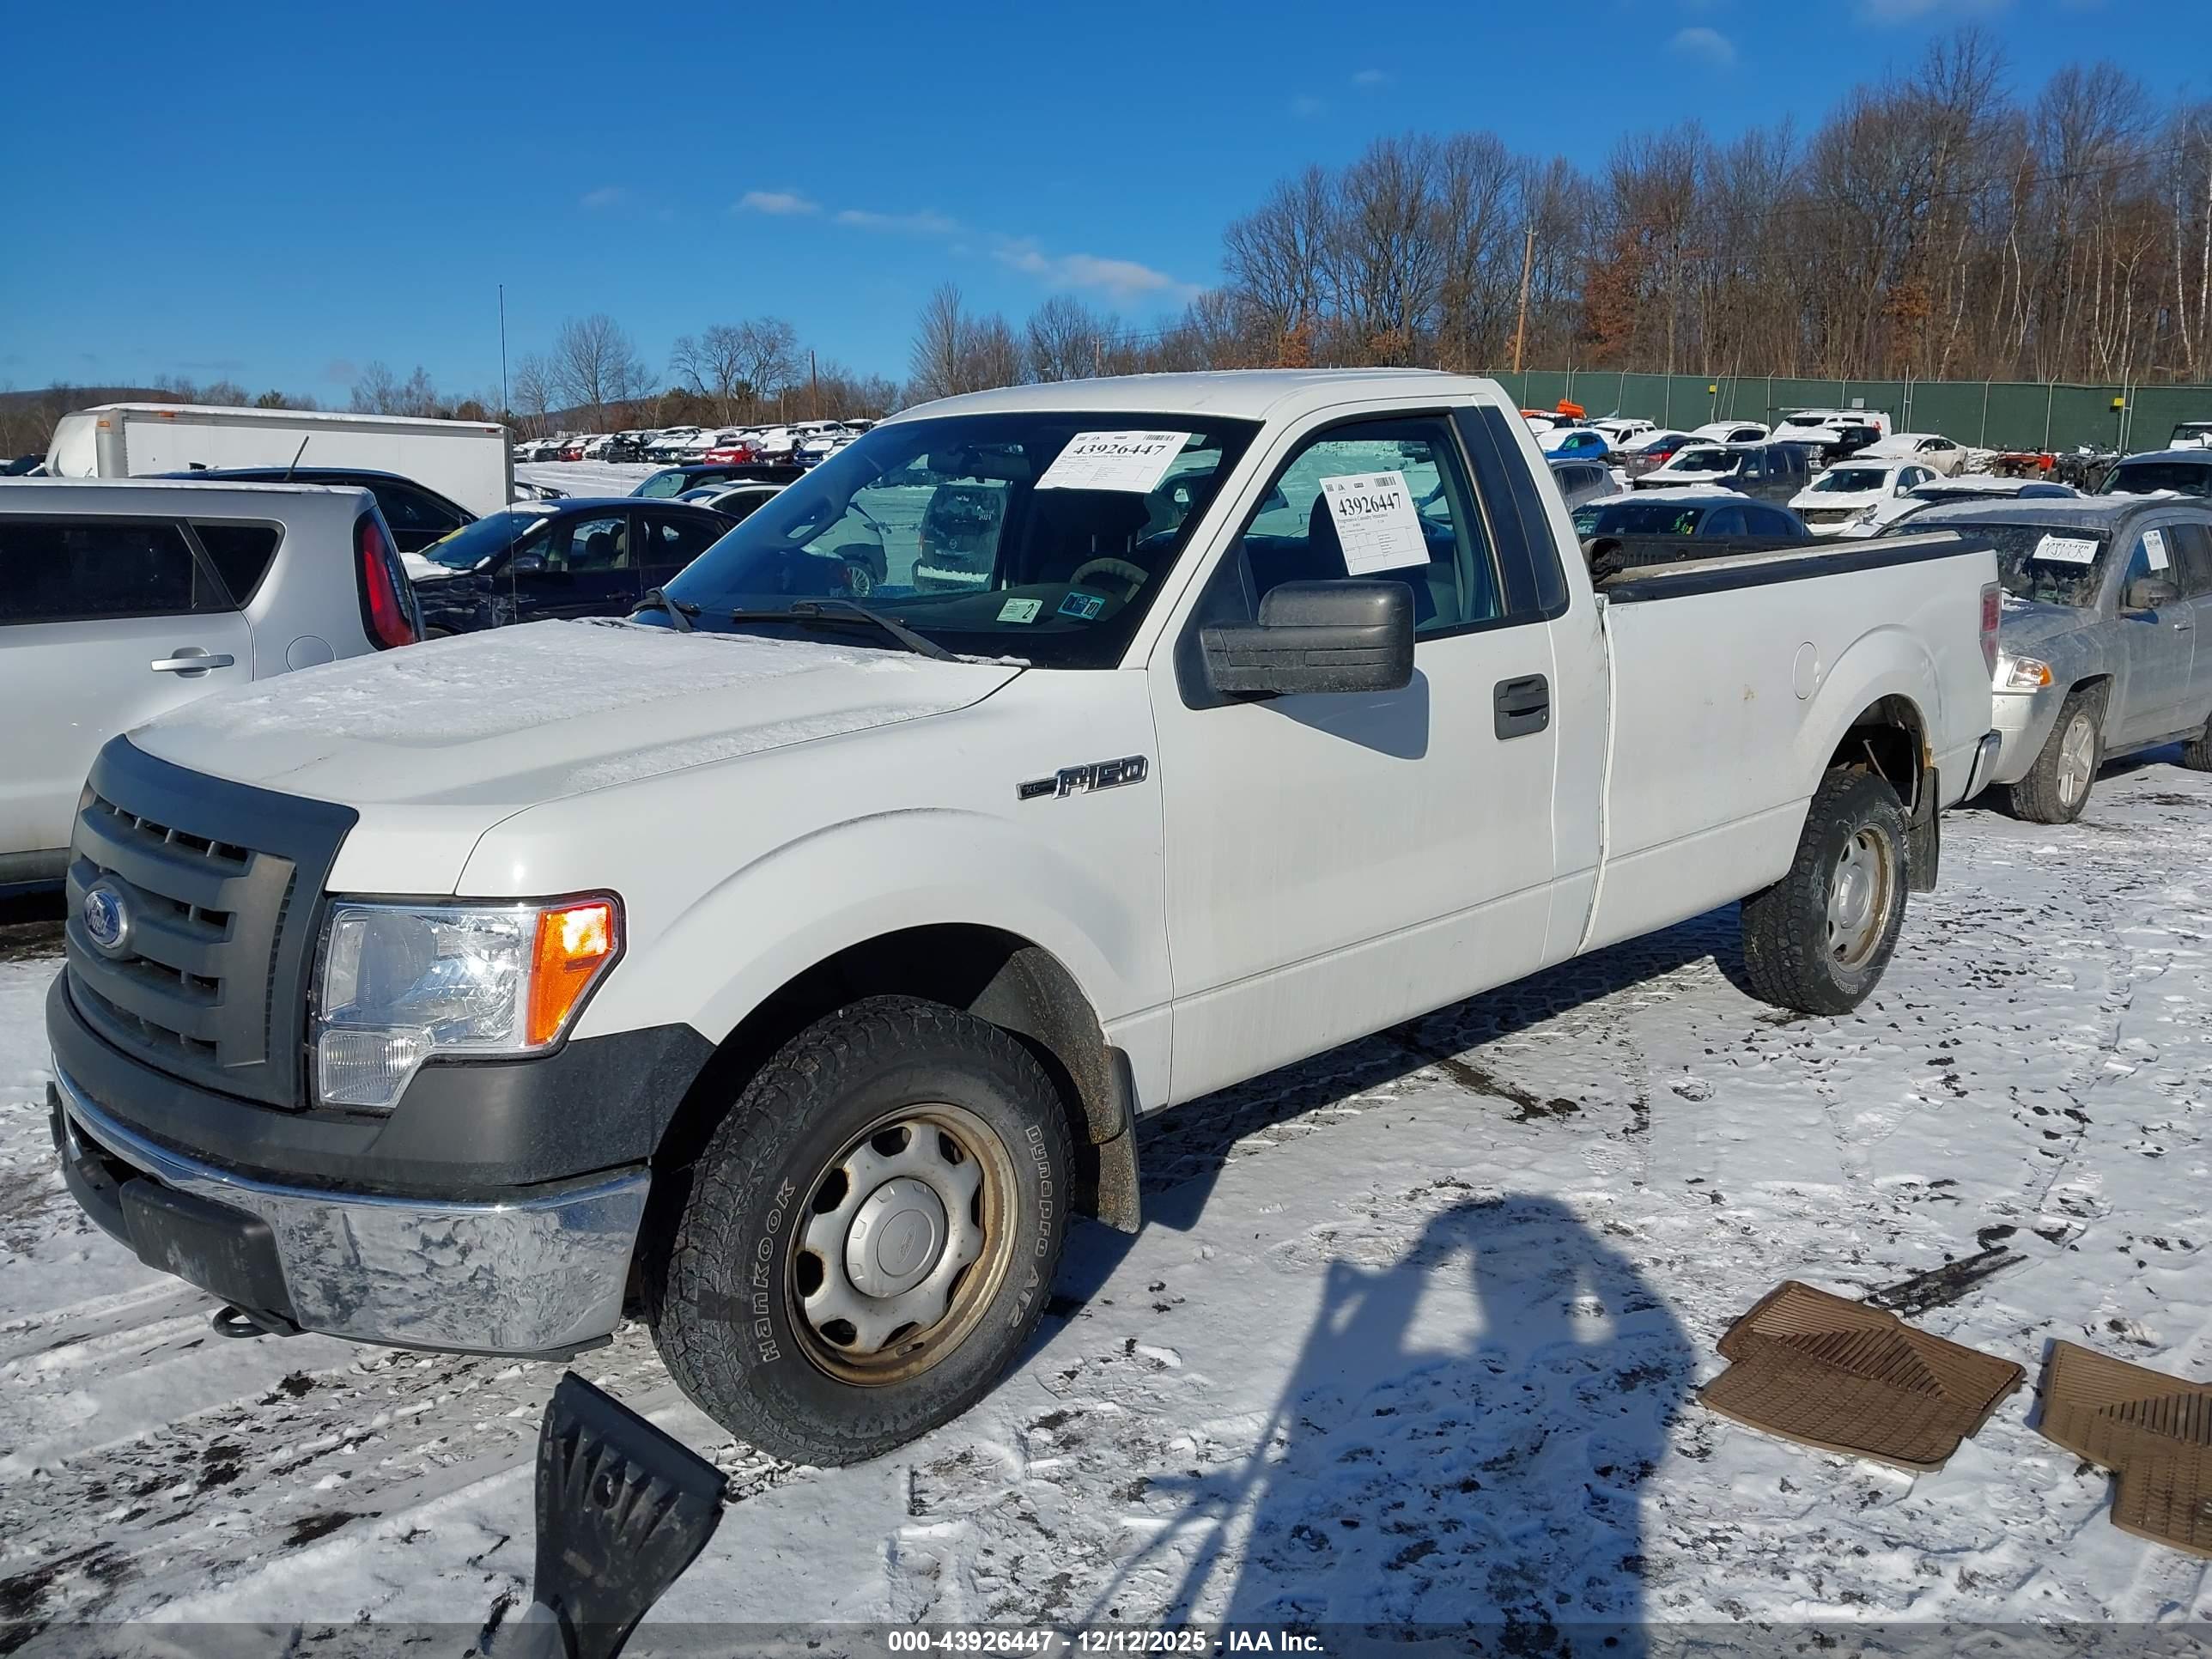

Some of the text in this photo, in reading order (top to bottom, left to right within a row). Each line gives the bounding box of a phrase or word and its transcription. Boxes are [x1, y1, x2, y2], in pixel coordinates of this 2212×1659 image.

[1073, 444, 1167, 455] 43926447
[1339, 493, 1401, 516] 43926447
[1021, 602, 1035, 619] 2
